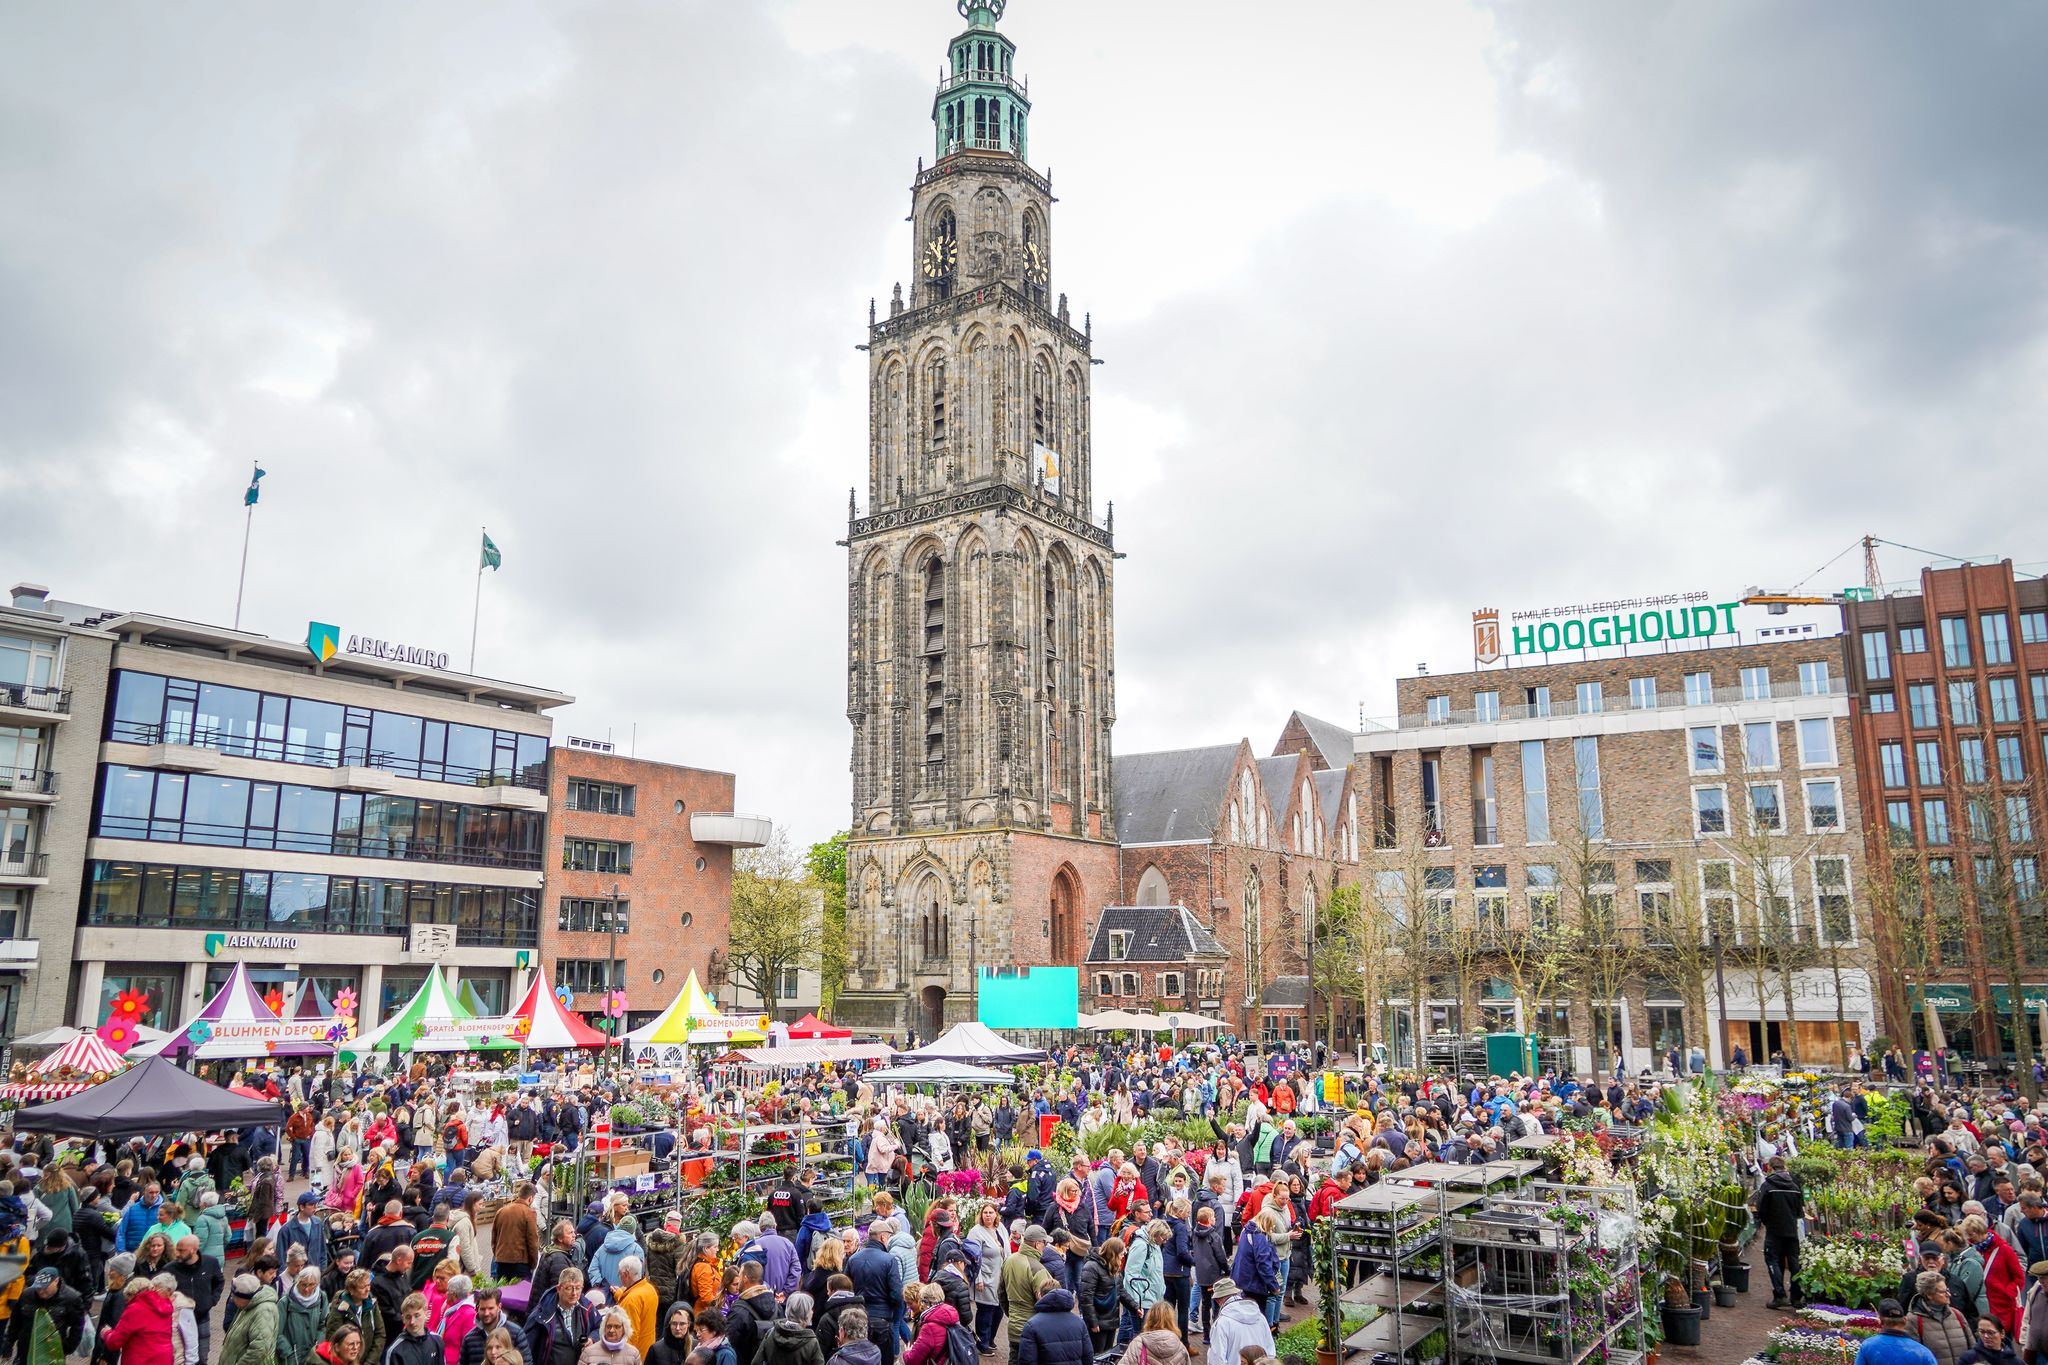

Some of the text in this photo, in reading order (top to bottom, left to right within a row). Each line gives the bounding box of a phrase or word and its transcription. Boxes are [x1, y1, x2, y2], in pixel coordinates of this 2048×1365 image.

[1512, 608, 1551, 621] FAMILIE
[1646, 594, 1679, 606] SINDS
[1682, 591, 1709, 602] 1888
[1512, 601, 1740, 655] HOOGHOUDT
[458, 1023, 514, 1031] BLOEMENDEPOT
[698, 1018, 758, 1028] BLOEMENDEPOT
[215, 1025, 327, 1037] BLUHMEN DEPOT
